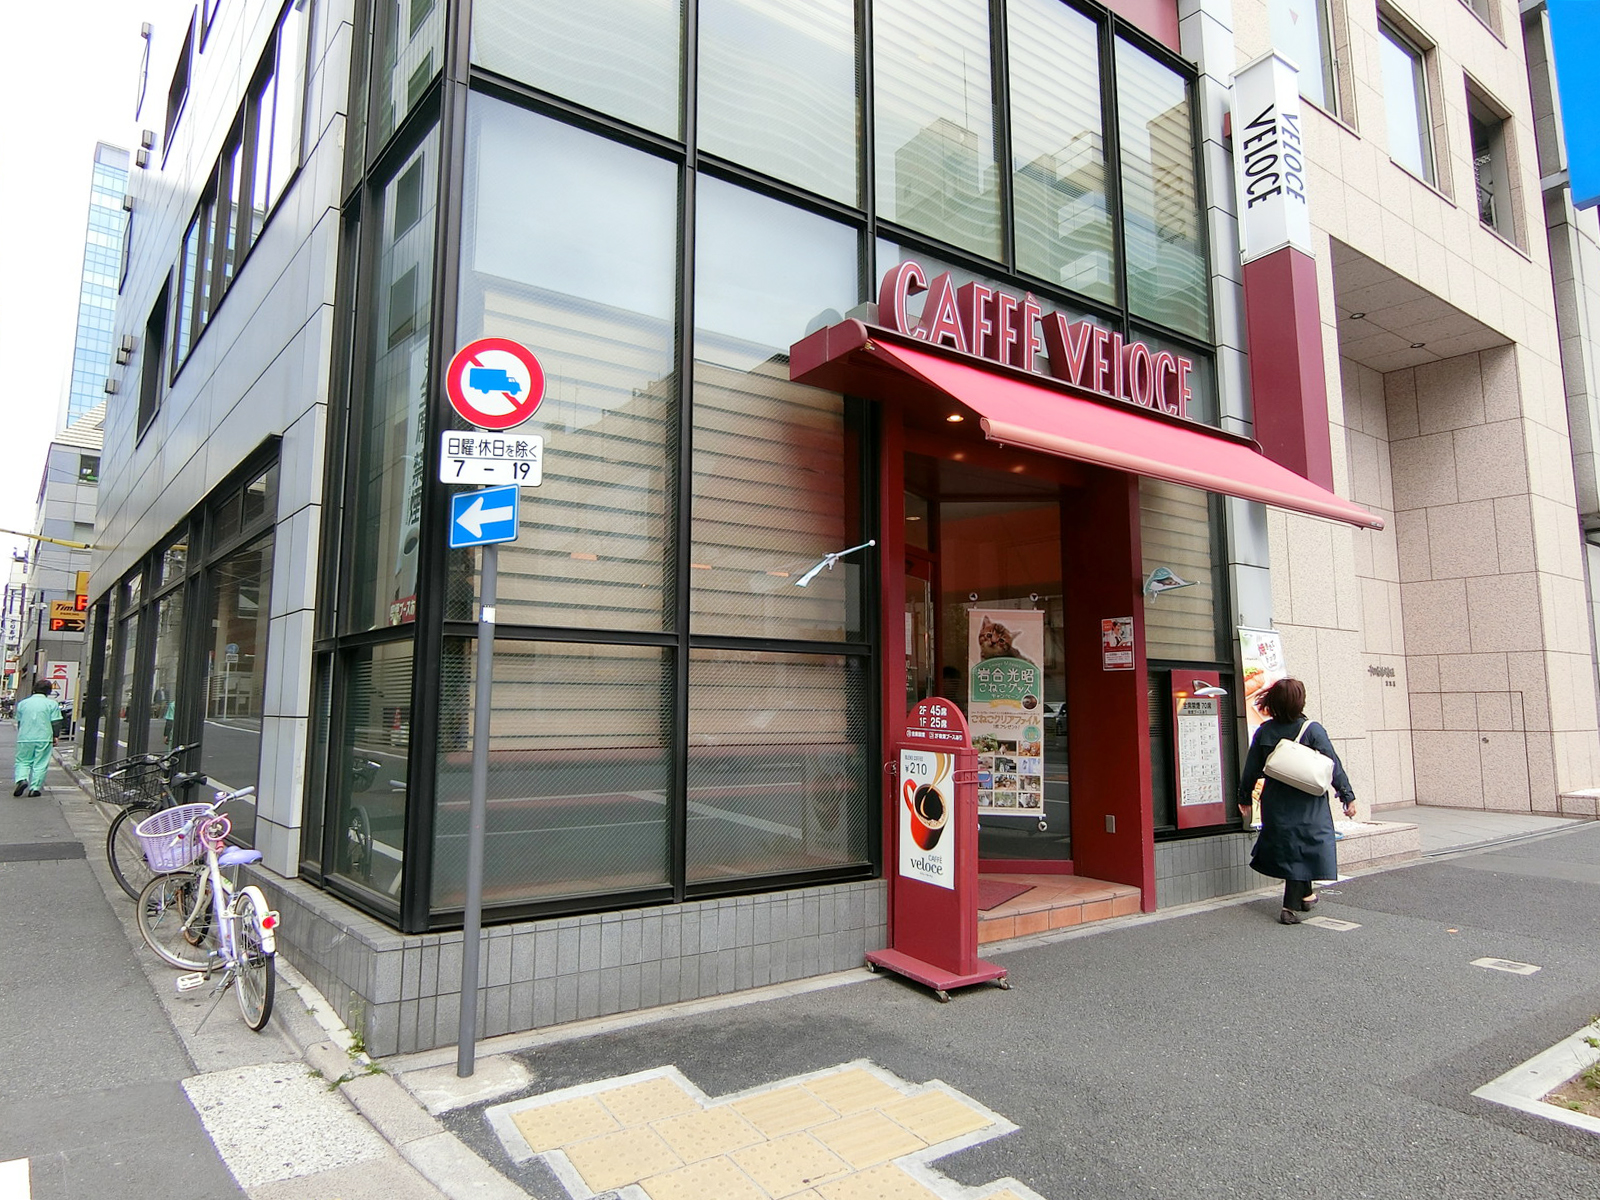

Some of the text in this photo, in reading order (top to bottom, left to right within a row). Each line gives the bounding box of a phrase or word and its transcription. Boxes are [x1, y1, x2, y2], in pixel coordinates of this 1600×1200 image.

[1243, 103, 1282, 209] VELOCE
[1281, 113, 1305, 204] VELOCE
[1042, 311, 1194, 420] VELOCE
[453, 460, 465, 477] 7
[513, 462, 530, 480] 19
[52, 619, 64, 631] P
[979, 682, 1033, 694] こねこグッズ
[919, 705, 927, 715] 2F
[919, 717, 927, 727] 1F
[971, 714, 1040, 725] こねこクリアファイル
[905, 762, 927, 775] ¥210
[910, 858, 943, 875] veloce
